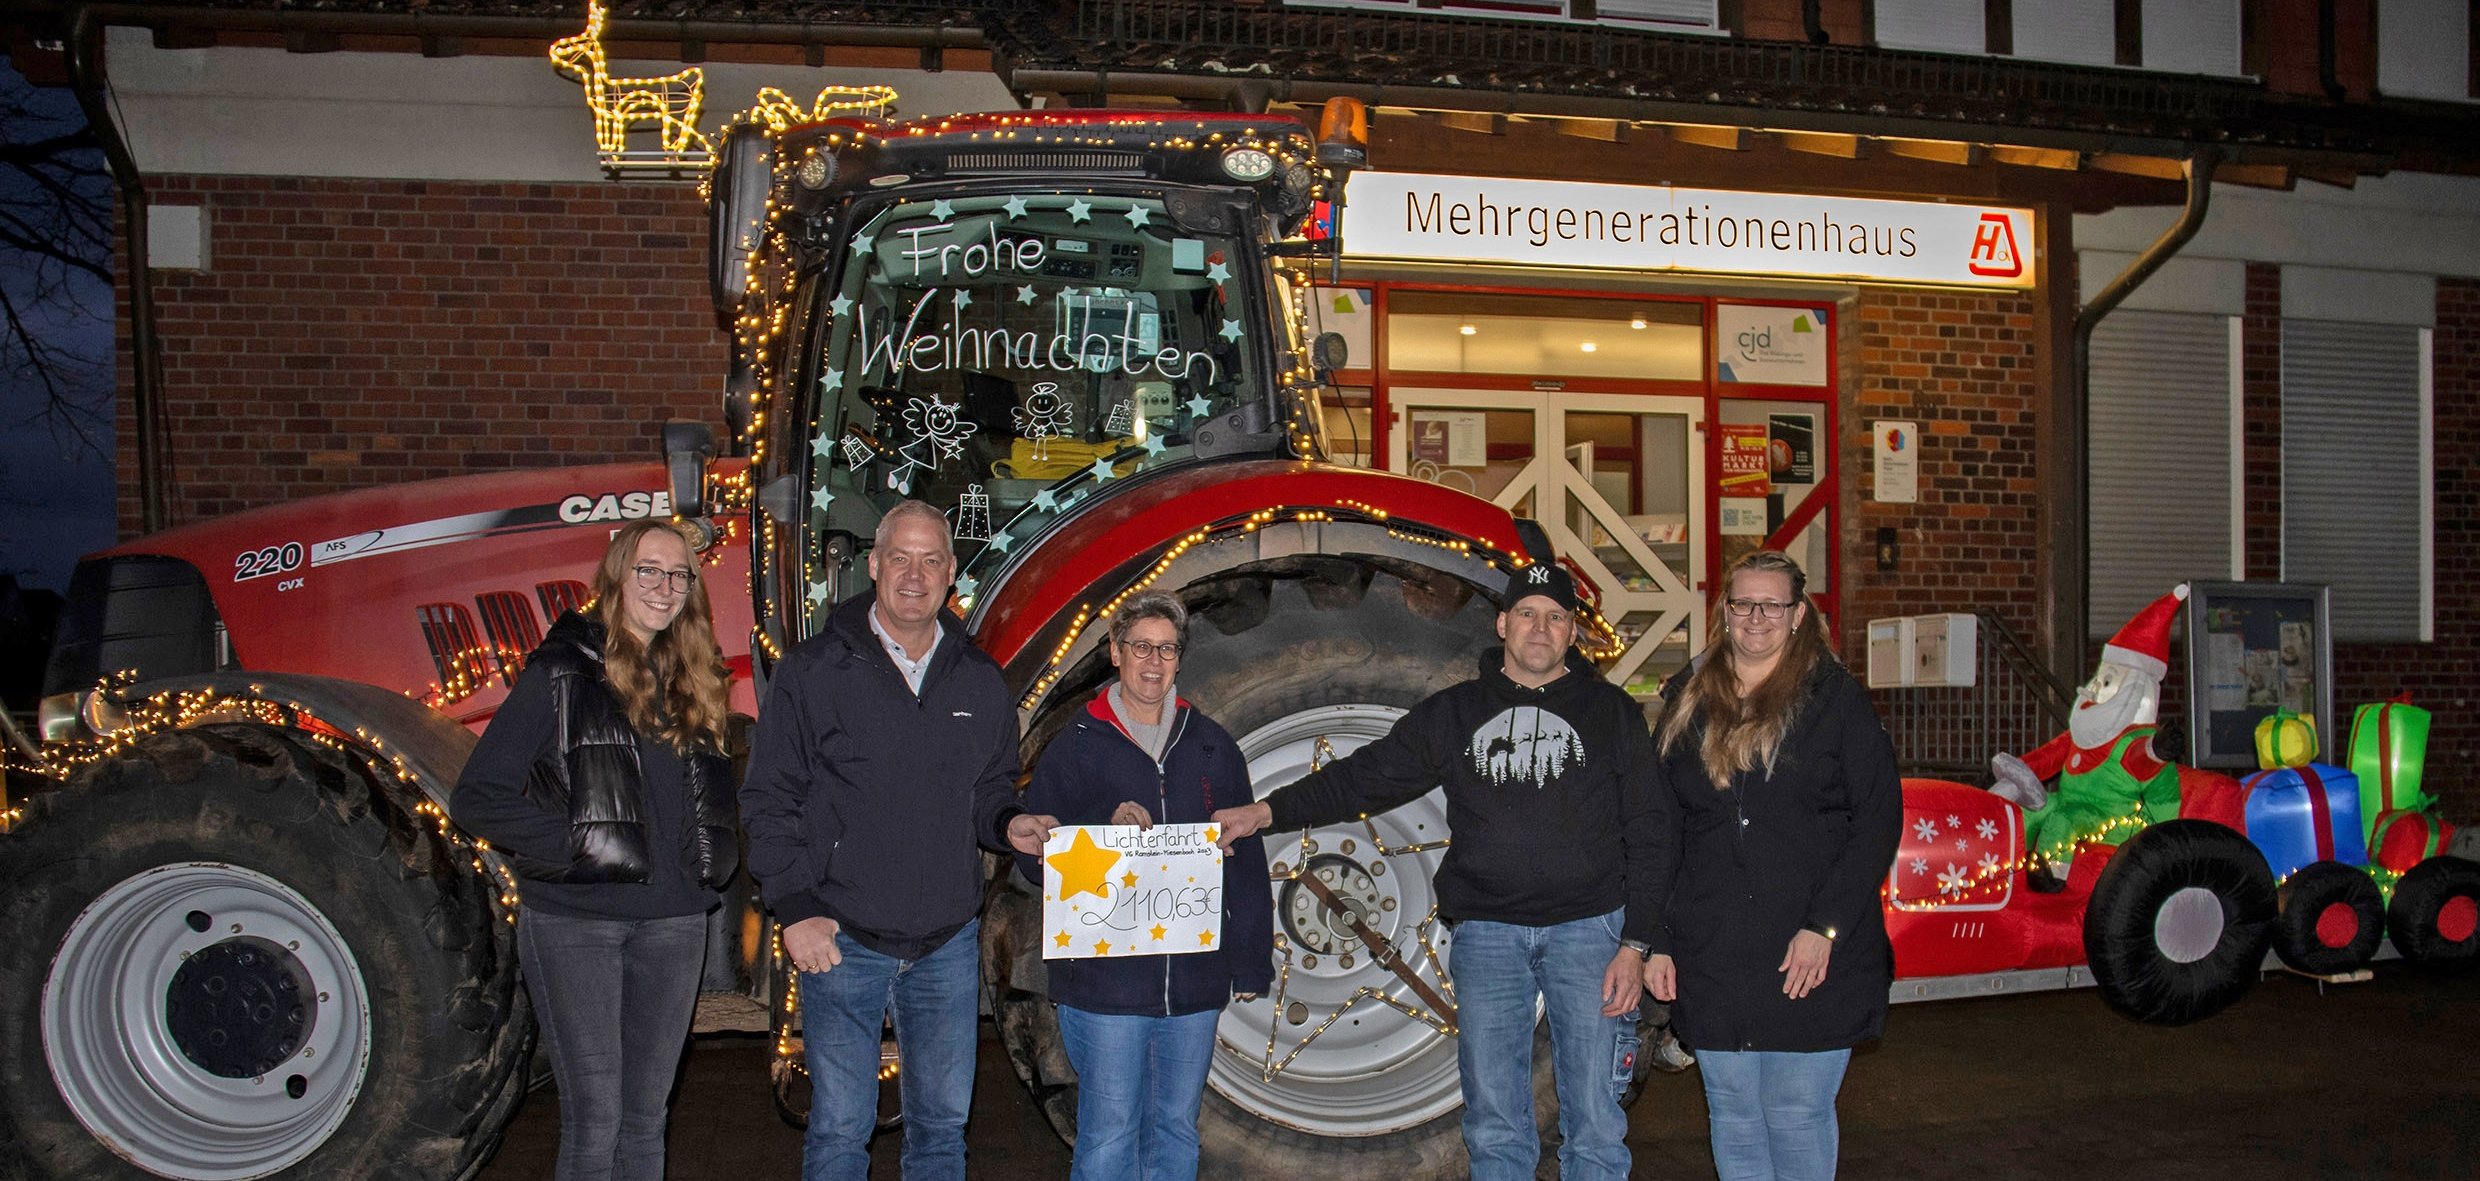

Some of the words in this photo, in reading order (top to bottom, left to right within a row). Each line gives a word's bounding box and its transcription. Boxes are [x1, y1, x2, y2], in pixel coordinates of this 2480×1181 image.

[1405, 190, 1918, 258] Mehrgenerationenhaus
[896, 221, 1046, 279] Frohe
[857, 288, 1216, 386] Weihnachten
[1737, 325, 1771, 354] cjd
[558, 490, 673, 524] CASE
[234, 541, 305, 582] 220
[325, 541, 346, 552] AFS
[277, 577, 305, 592] CVX
[1527, 565, 1550, 584] NY
[1102, 825, 1201, 849] Lichterfahrt
